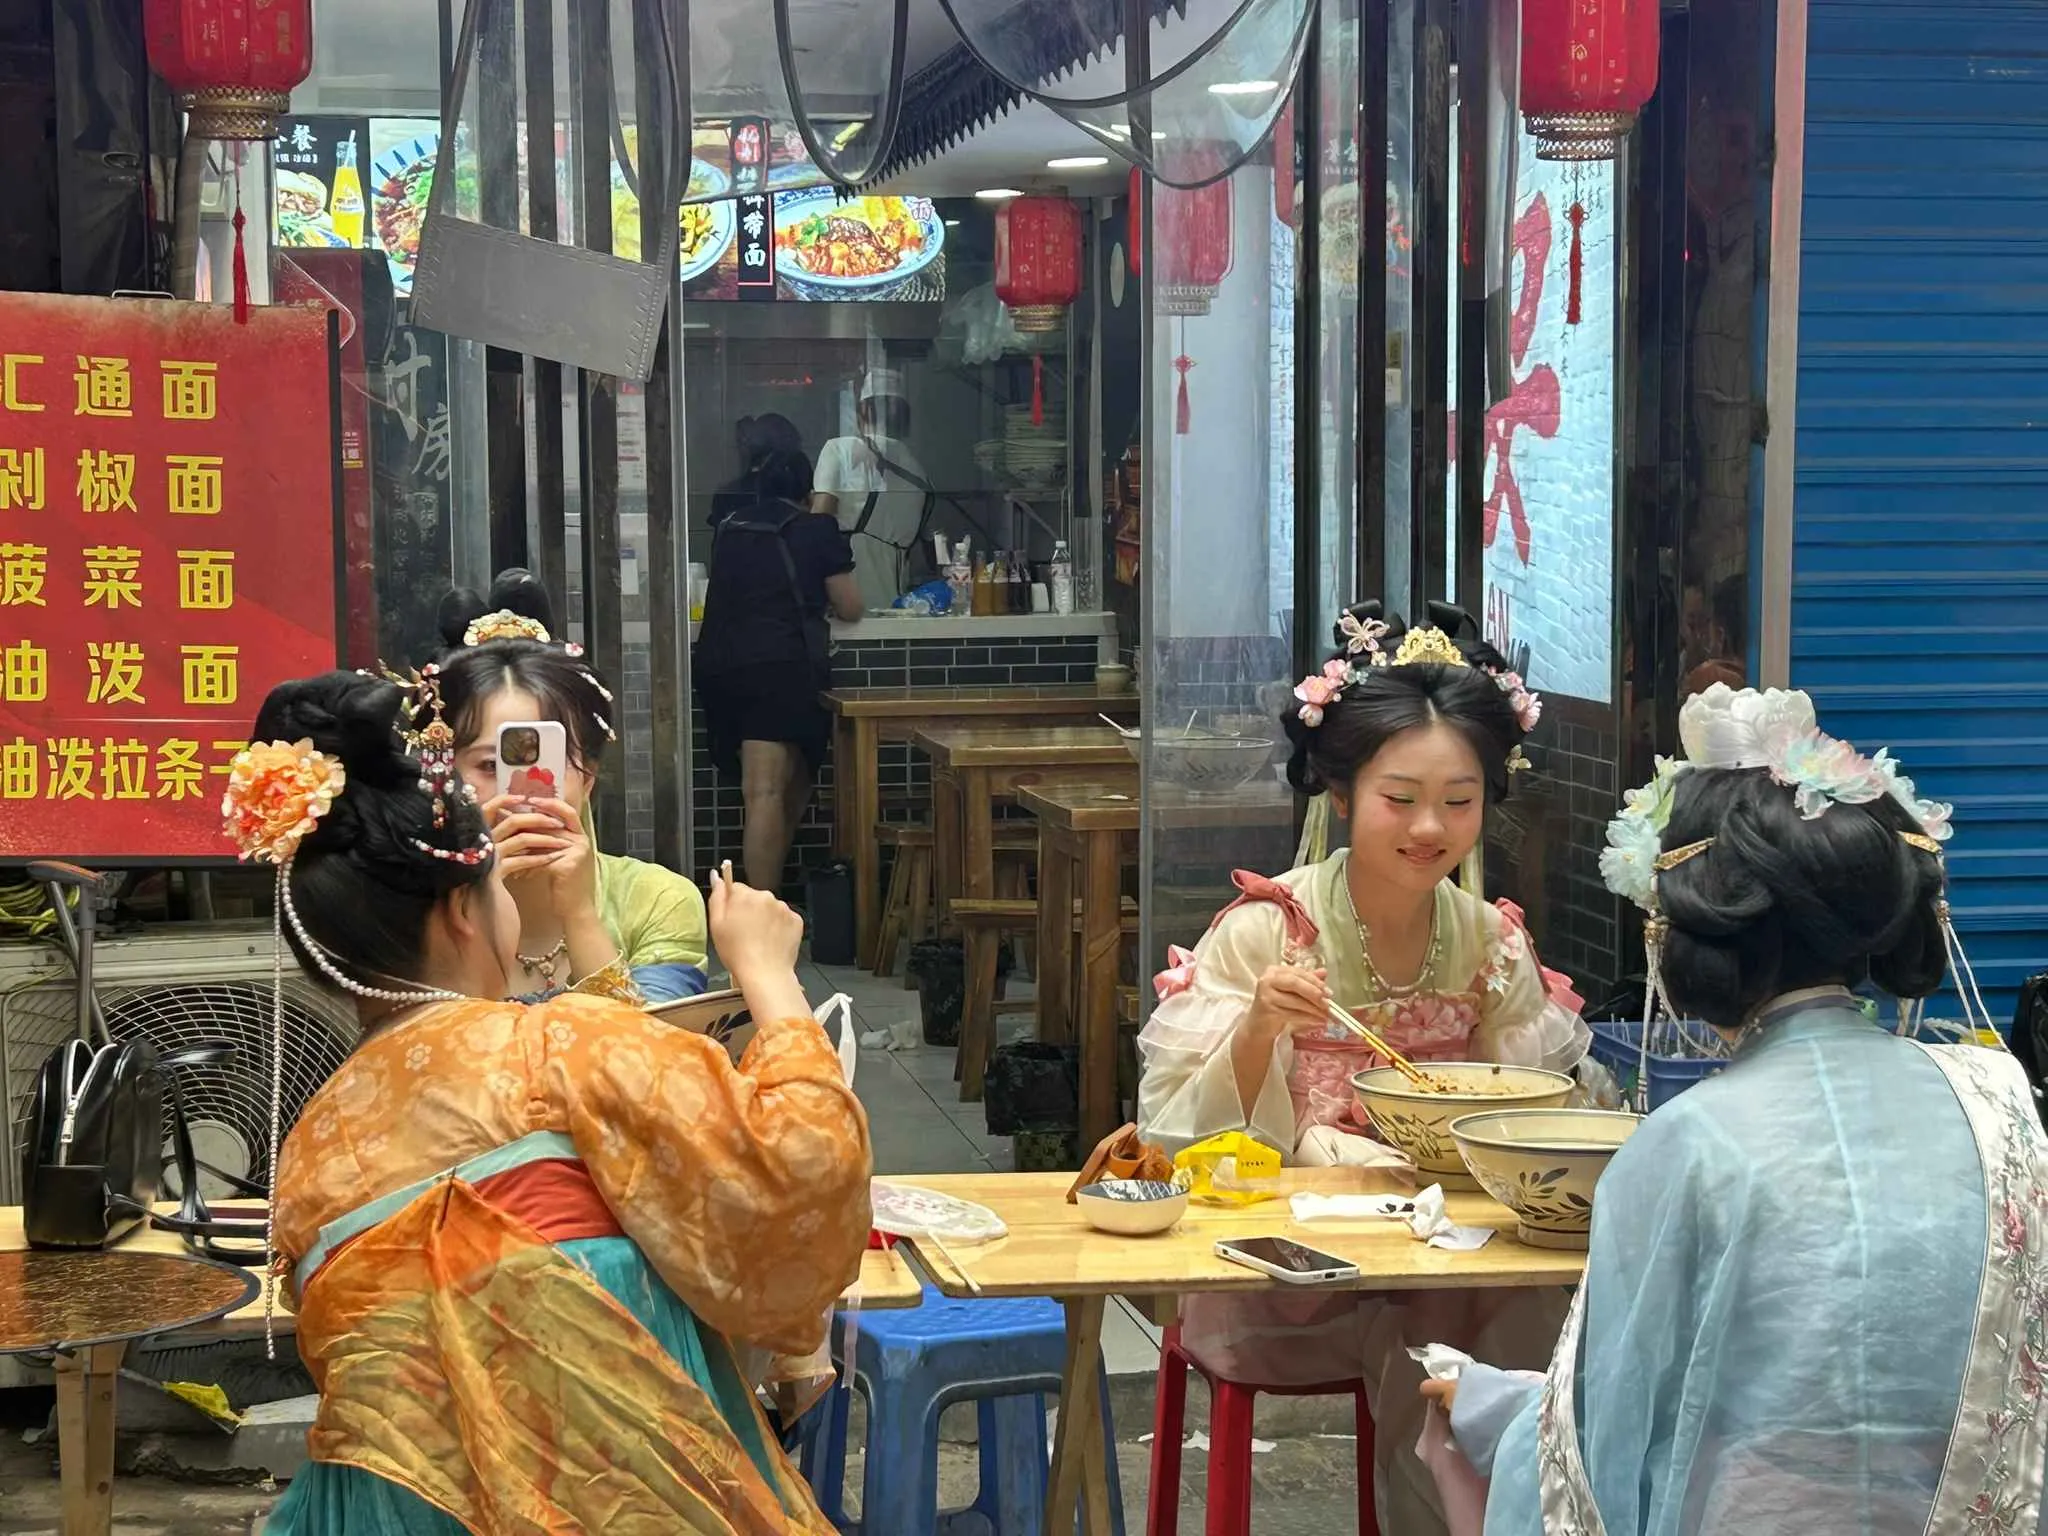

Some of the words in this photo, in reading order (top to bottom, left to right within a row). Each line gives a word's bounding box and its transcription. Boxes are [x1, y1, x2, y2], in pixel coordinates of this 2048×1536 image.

[0, 354, 218, 420] 汇通面
[0, 543, 235, 609] 菠菜面
[0, 639, 239, 705] 油泼面
